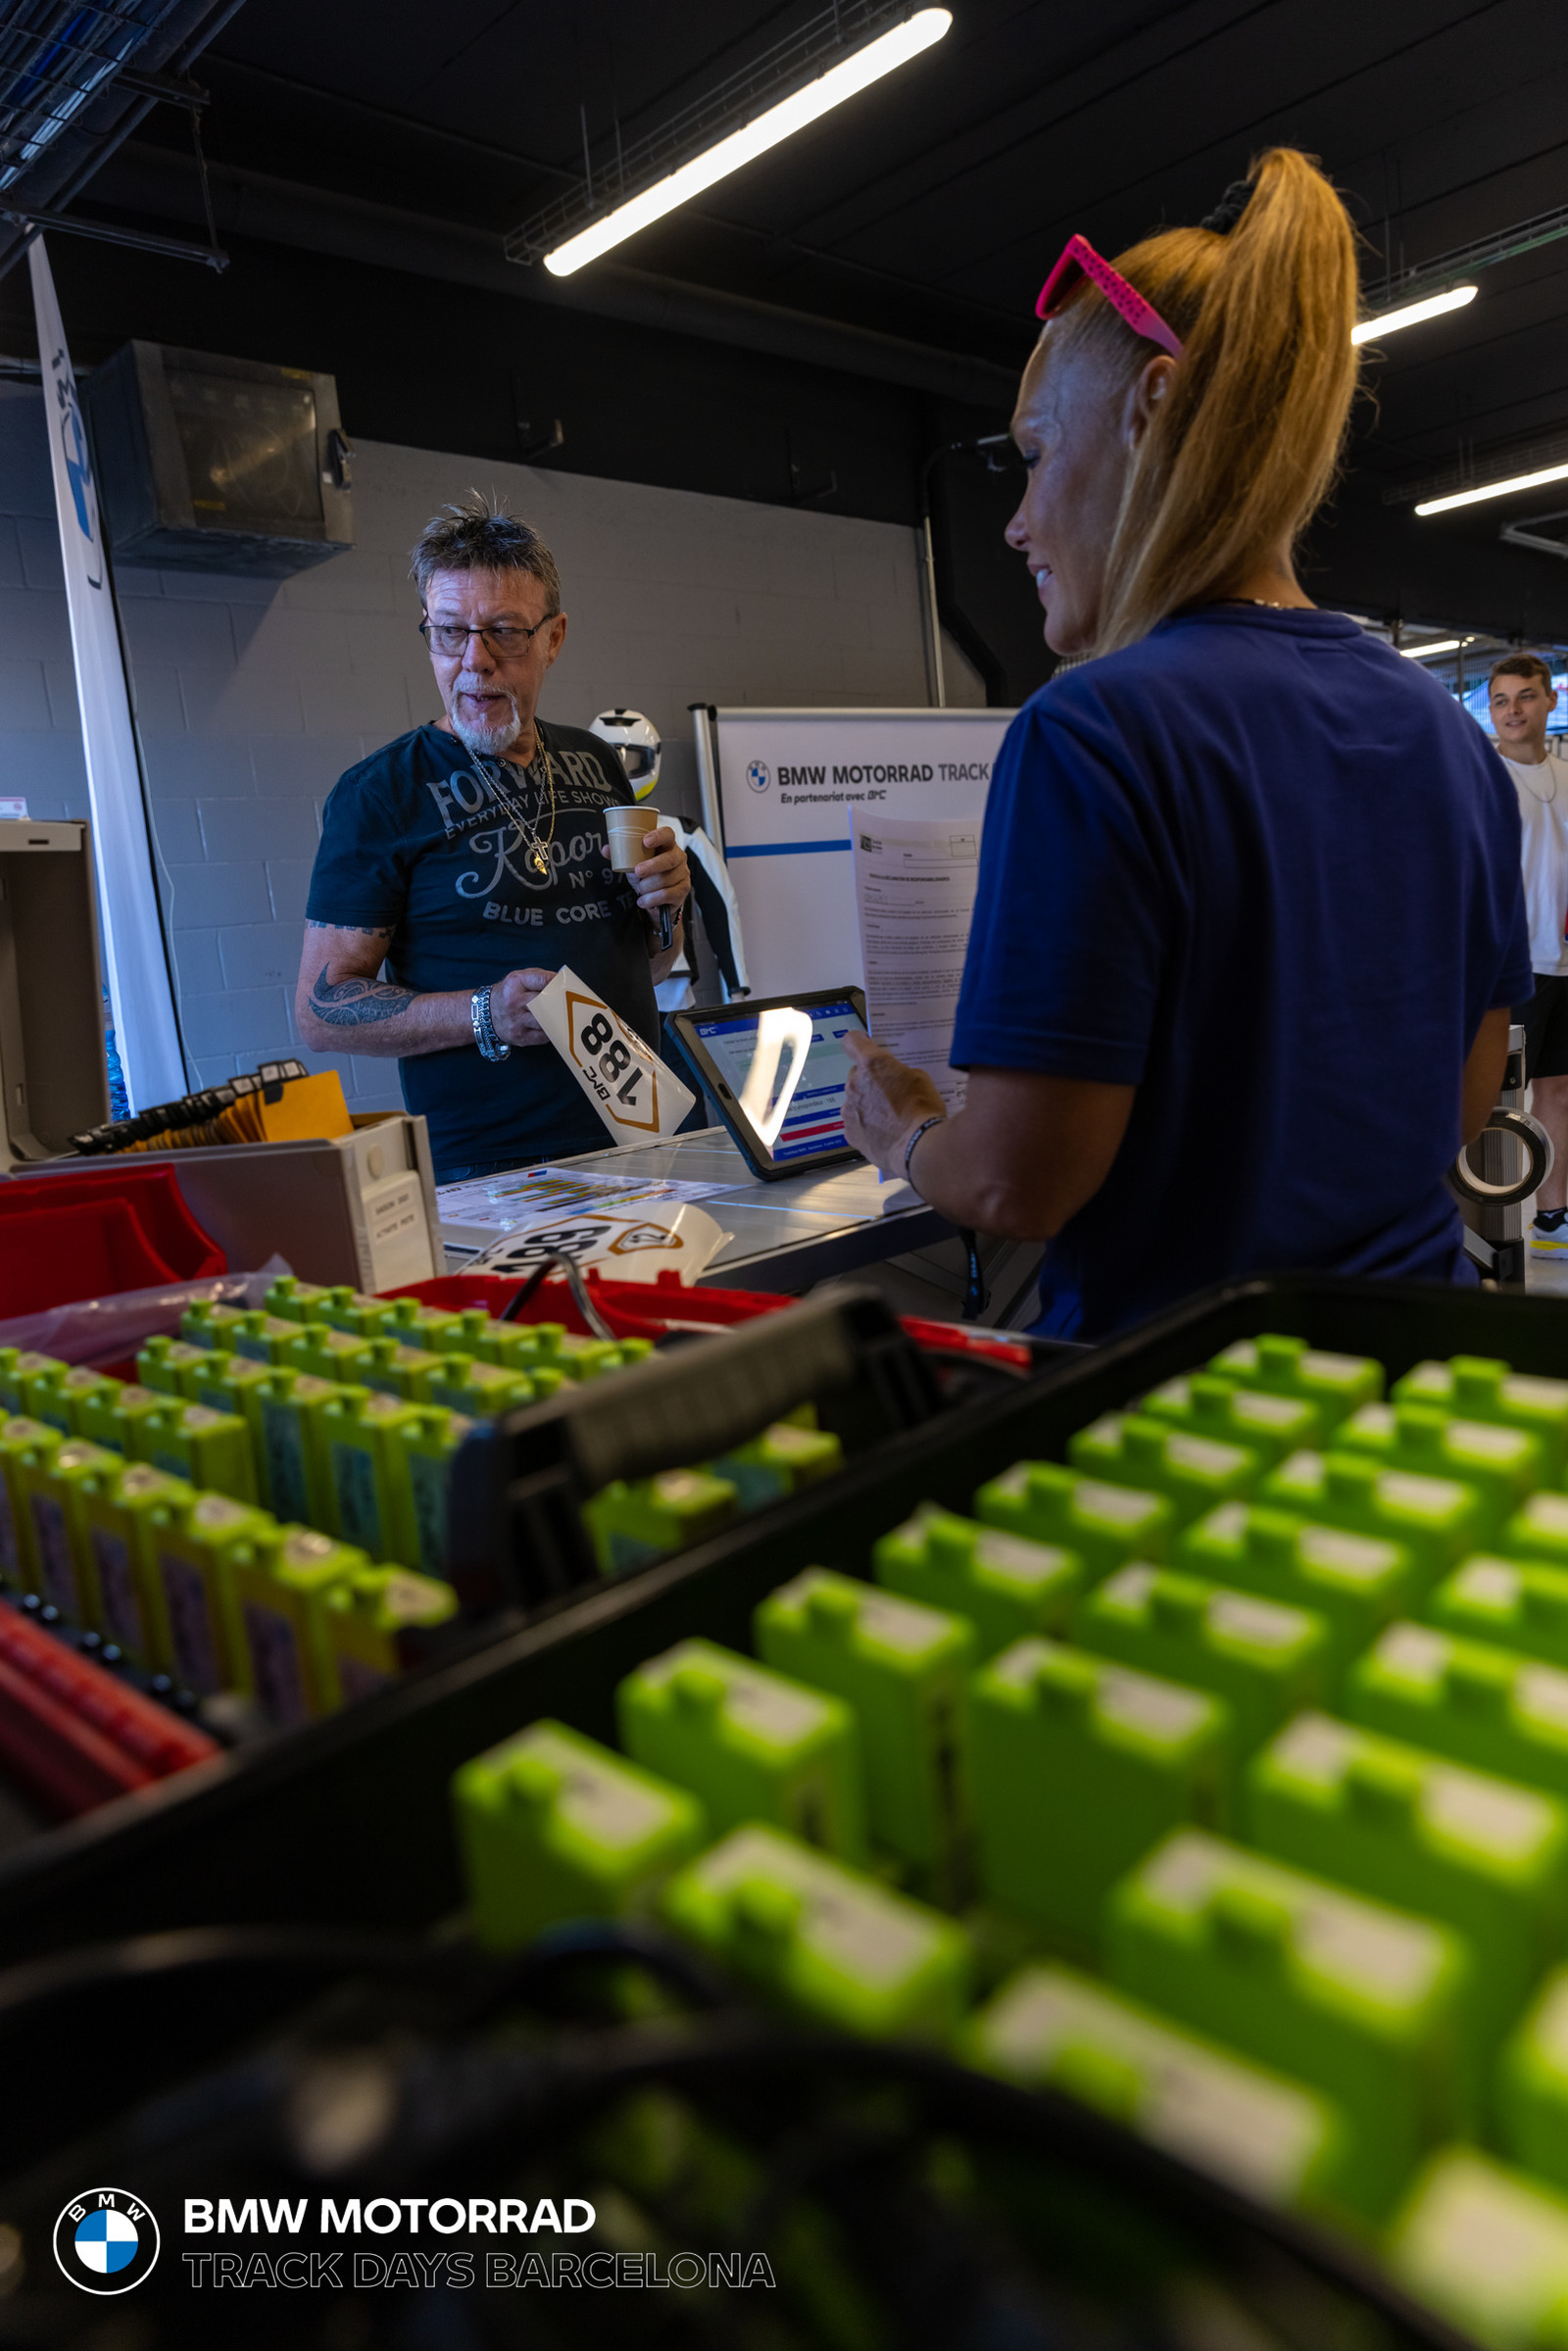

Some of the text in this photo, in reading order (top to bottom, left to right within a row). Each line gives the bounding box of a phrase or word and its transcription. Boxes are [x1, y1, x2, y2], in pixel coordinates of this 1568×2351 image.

[426, 751, 612, 828] FORWARD
[777, 762, 990, 786] BMW MOTORRAD TRACK
[780, 793, 793, 804] En
[794, 791, 845, 806] partenariat
[846, 792, 865, 803] avec
[444, 793, 529, 841] EVERYDAY
[534, 791, 569, 806] LIFE
[455, 808, 608, 900] Kapor
[482, 901, 544, 927] BLUE
[556, 900, 612, 925] CORE
[581, 1012, 644, 1106] 188
[581, 1065, 612, 1102] BMC
[490, 1225, 612, 1275] 189
